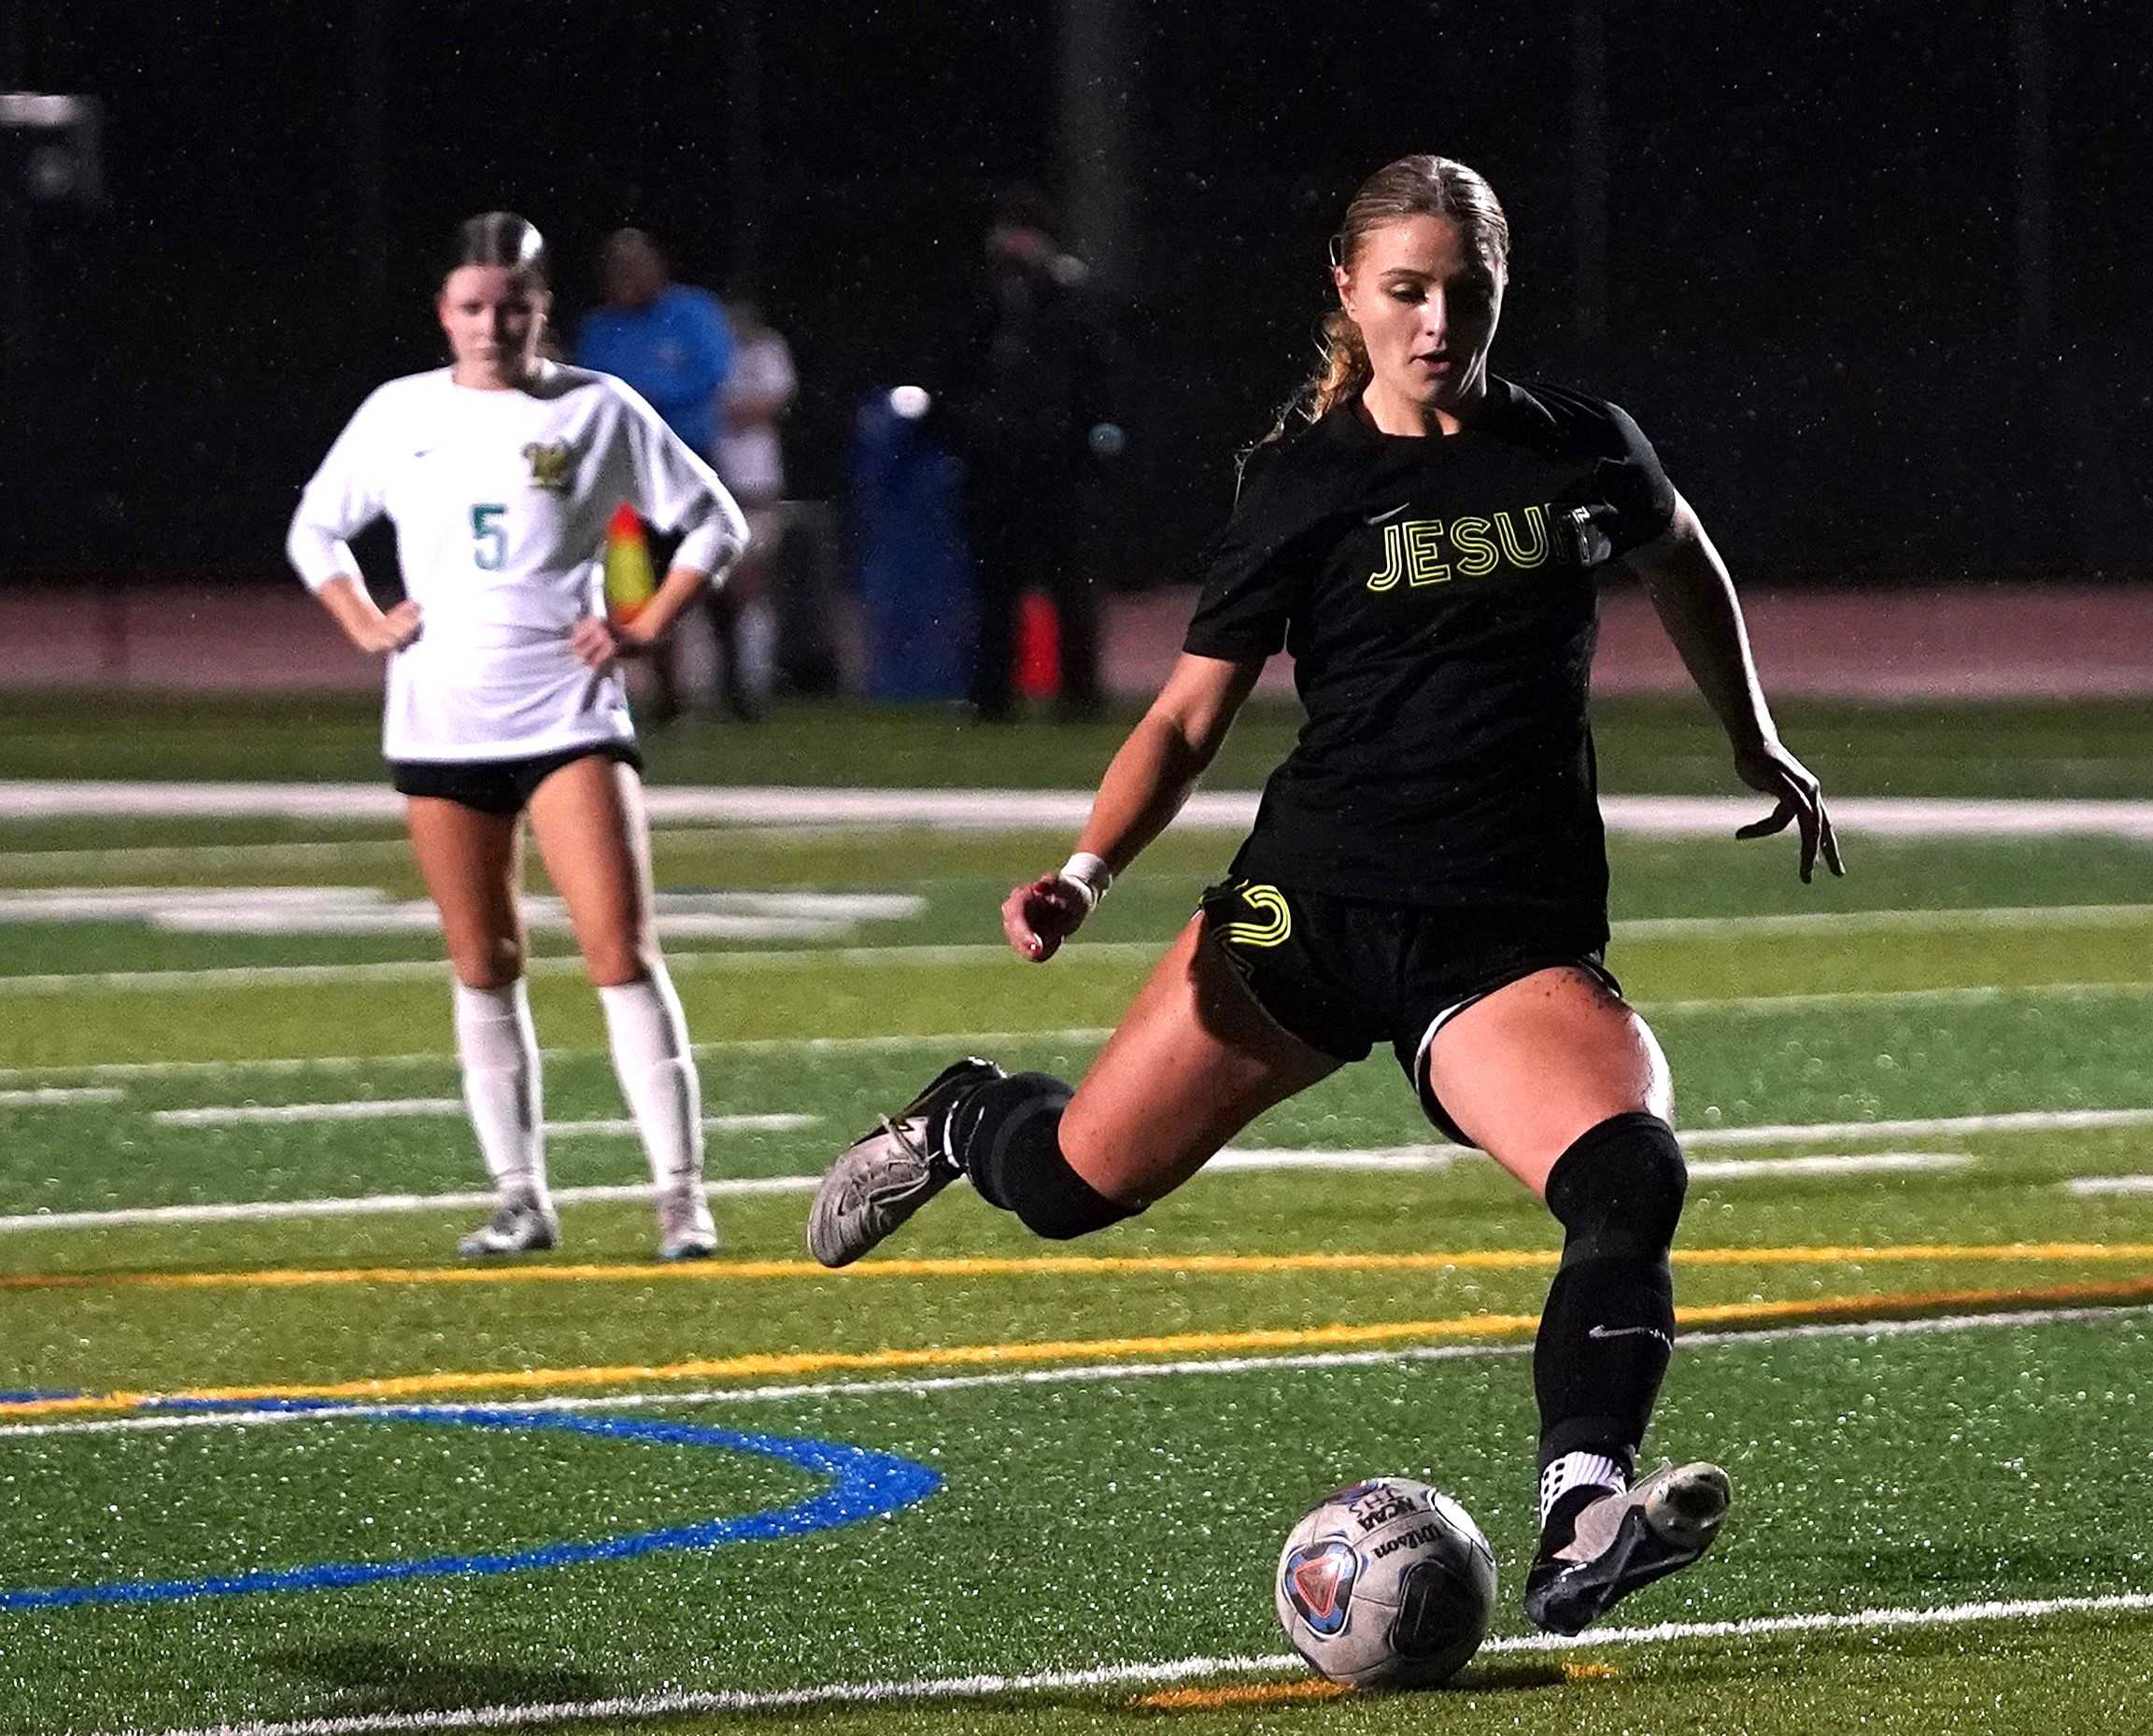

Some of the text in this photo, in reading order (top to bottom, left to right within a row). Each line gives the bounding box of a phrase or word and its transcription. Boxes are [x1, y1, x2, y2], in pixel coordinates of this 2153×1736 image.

[469, 503, 508, 571] 5
[1367, 502, 1592, 591] JESU
[1373, 1523, 1444, 1559] Wilson
